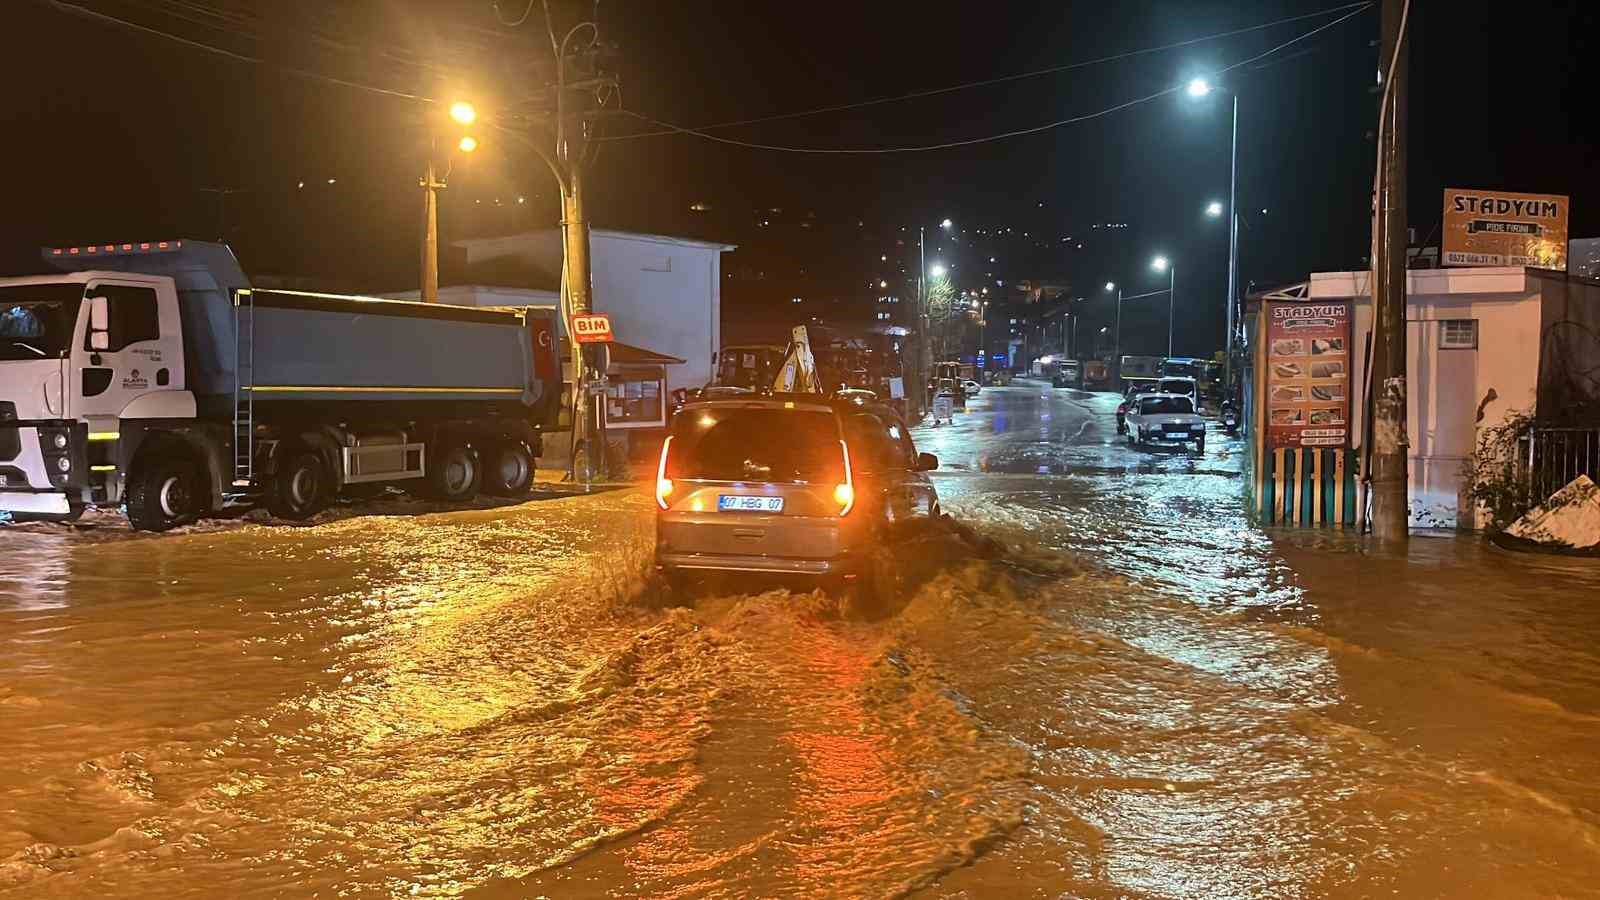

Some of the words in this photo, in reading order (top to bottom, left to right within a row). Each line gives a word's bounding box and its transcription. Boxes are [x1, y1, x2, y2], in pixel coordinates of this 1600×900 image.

[1454, 195, 1557, 218] STADYUM
[1274, 305, 1345, 318] STADYUM
[769, 499, 781, 509] 07
